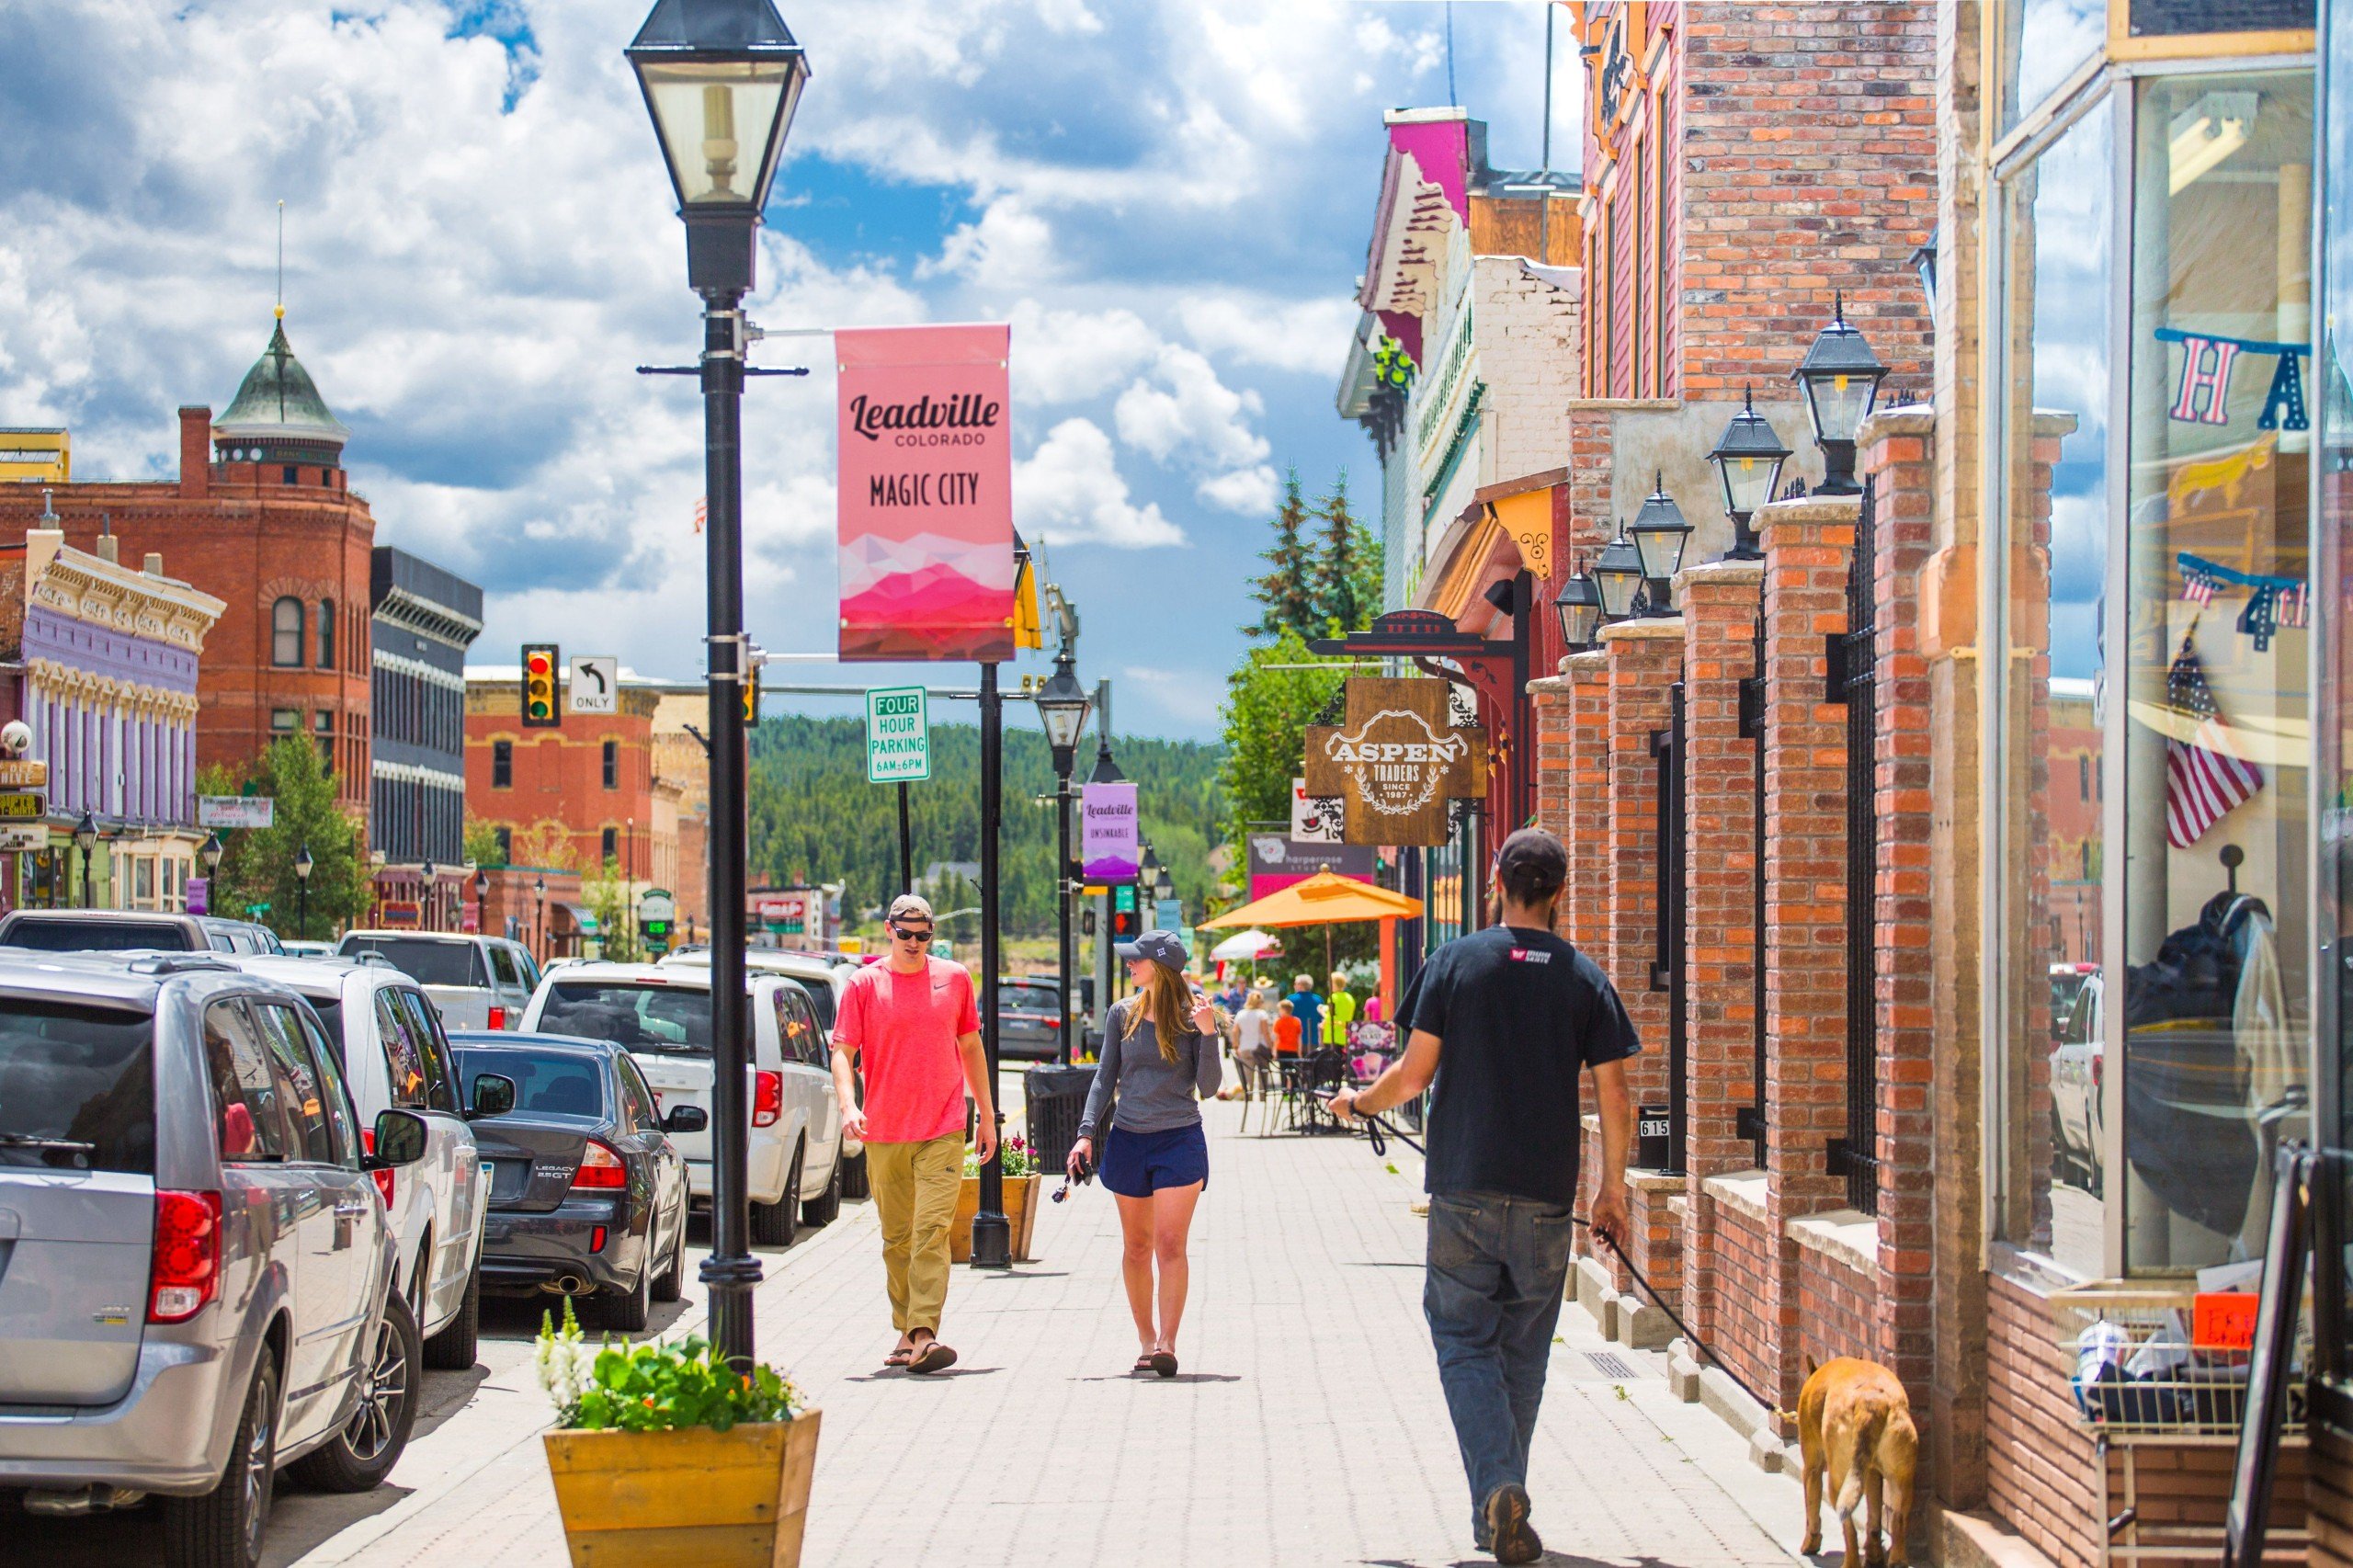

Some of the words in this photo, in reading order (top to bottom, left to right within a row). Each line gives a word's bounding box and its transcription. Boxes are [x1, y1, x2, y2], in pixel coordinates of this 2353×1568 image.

[850, 393, 1000, 441] Leadville
[895, 433, 985, 447] COLORADO
[870, 473, 931, 506] MAGIC
[938, 472, 979, 506] CITY
[576, 697, 609, 708] ONLY
[877, 697, 918, 714] FOUR
[880, 717, 915, 733] HOUR
[871, 736, 925, 755] PARKING
[1332, 744, 1459, 763] ASPEN
[1373, 764, 1420, 782] TRADERS
[1382, 783, 1411, 791] SINCE
[1086, 803, 1133, 820] Leadville
[1090, 828, 1129, 839] UNSINKABLE
[1642, 1121, 1667, 1135] 615
